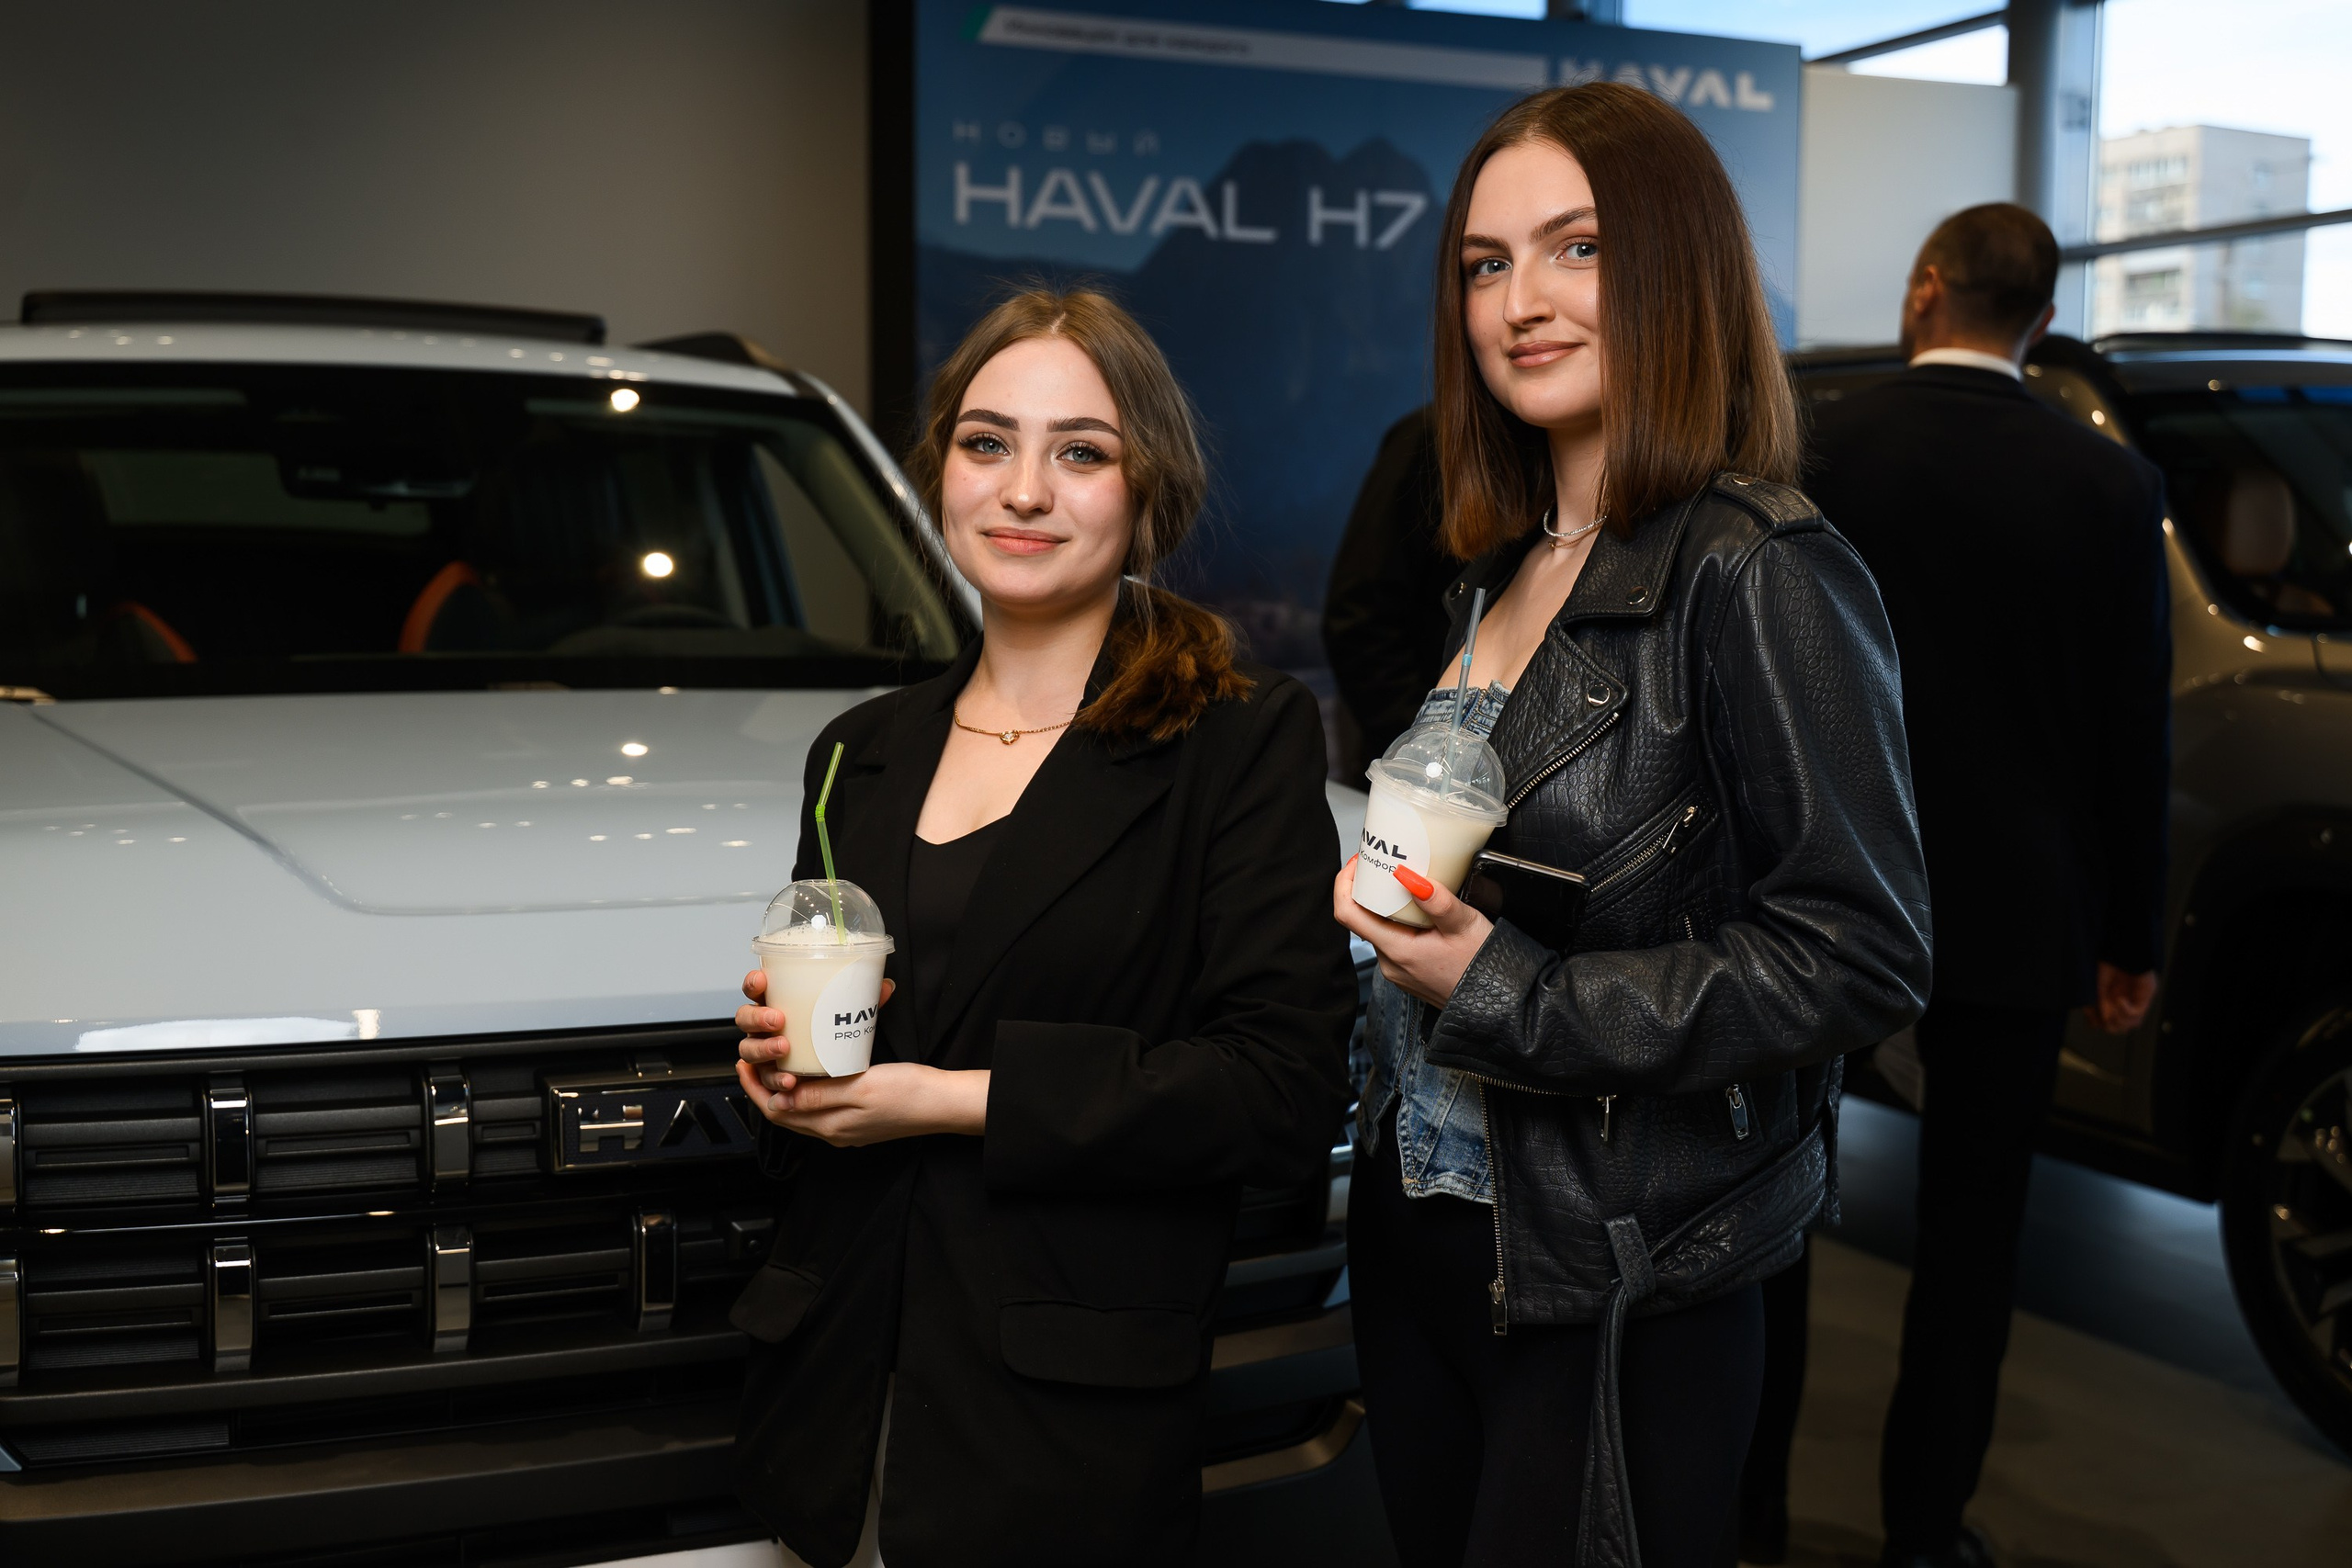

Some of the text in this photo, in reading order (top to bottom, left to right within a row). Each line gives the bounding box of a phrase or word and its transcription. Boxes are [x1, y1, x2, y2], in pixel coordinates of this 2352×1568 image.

[954, 162, 1428, 250] HAVAL H7
[1361, 849, 1396, 873] Комфор
[835, 1005, 877, 1026] HAV
[834, 1029, 861, 1041] PRO
